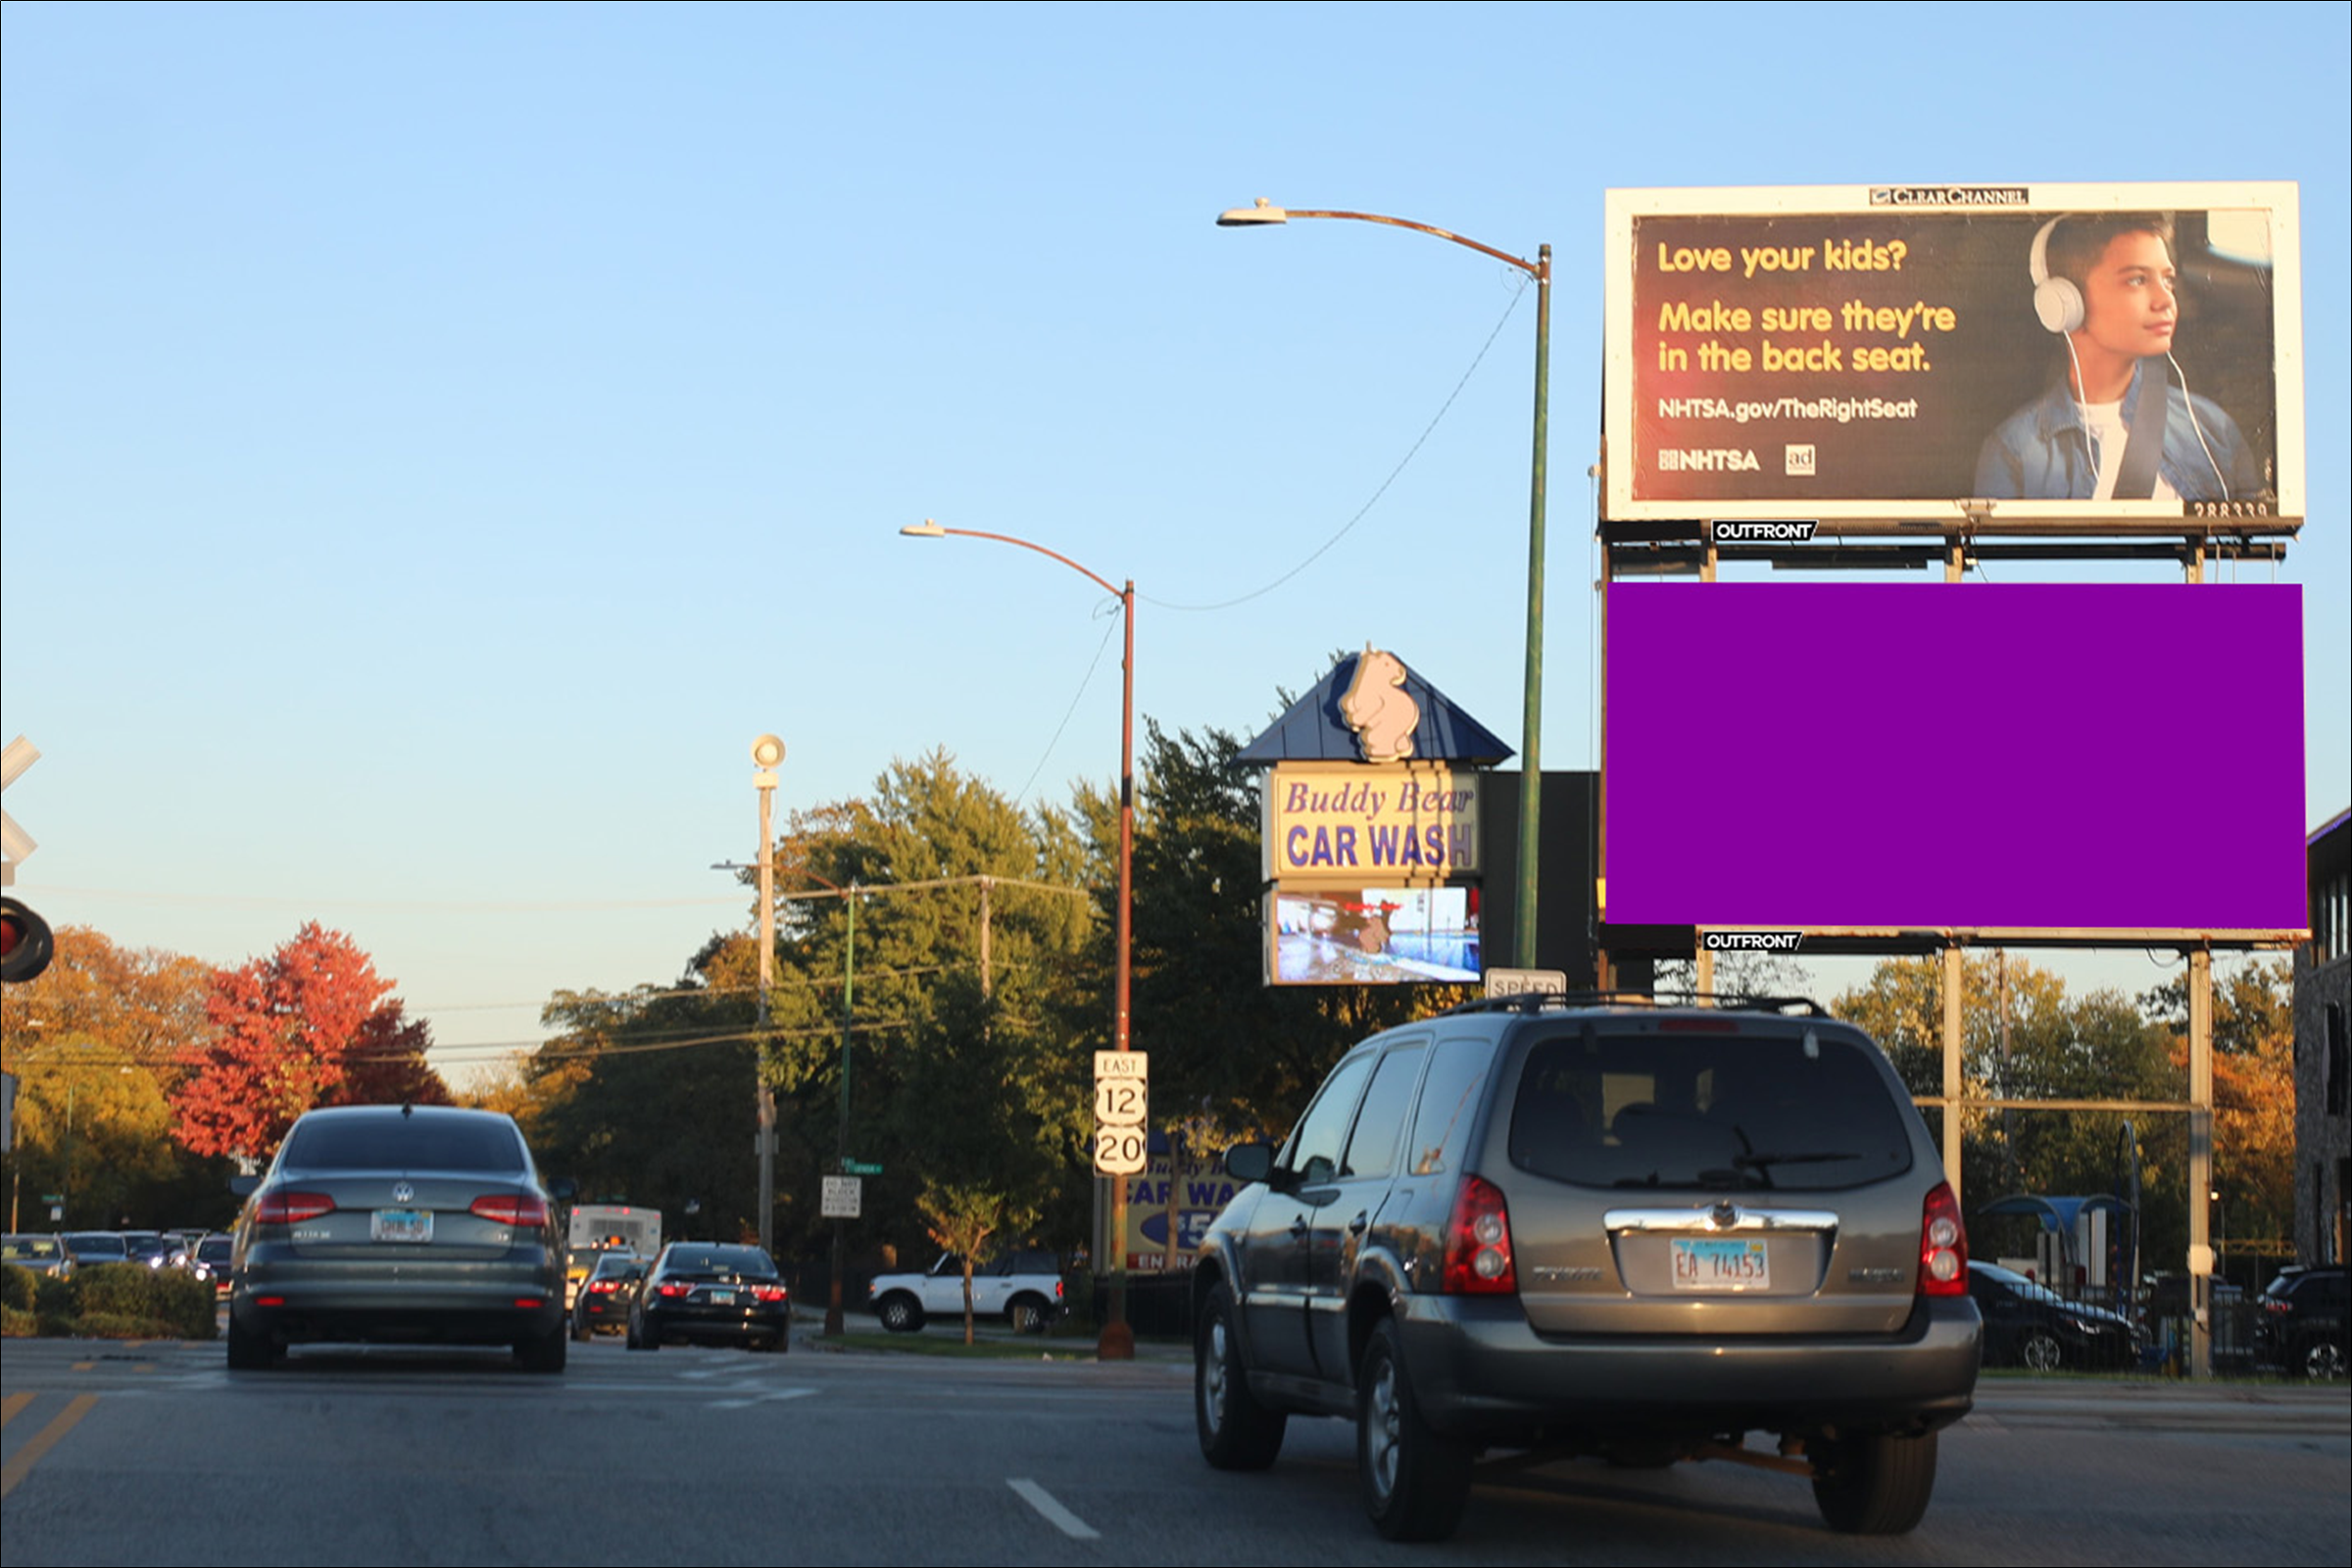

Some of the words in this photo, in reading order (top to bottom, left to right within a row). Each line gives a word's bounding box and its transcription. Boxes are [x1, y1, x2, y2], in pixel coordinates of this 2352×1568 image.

[1658, 242, 1732, 271] Love
[1740, 247, 1815, 278] your
[1824, 238, 1907, 271] kids?
[1658, 300, 1751, 331] Make
[1761, 307, 1833, 331] sure
[1841, 299, 1956, 338] they're
[1658, 341, 1688, 371] in
[1698, 340, 1751, 371] the
[1762, 339, 1842, 371] back
[1852, 342, 1931, 371] seat.
[1658, 397, 1918, 422] NHTSA.gov/TheRightSeat
[1680, 449, 1761, 471] NHTSA
[1788, 449, 1813, 465] ad
[1284, 781, 1388, 820] Buddy
[1396, 782, 1474, 813] Bear
[1287, 824, 1358, 867] CAR
[1368, 824, 1471, 867] WASH
[1494, 980, 1558, 996] SPEED
[1103, 1058, 1138, 1072] EAST
[1105, 1087, 1136, 1114] 12
[1100, 1135, 1141, 1161] 20
[1676, 1252, 1698, 1278] EA
[1711, 1253, 1765, 1278] 74153
